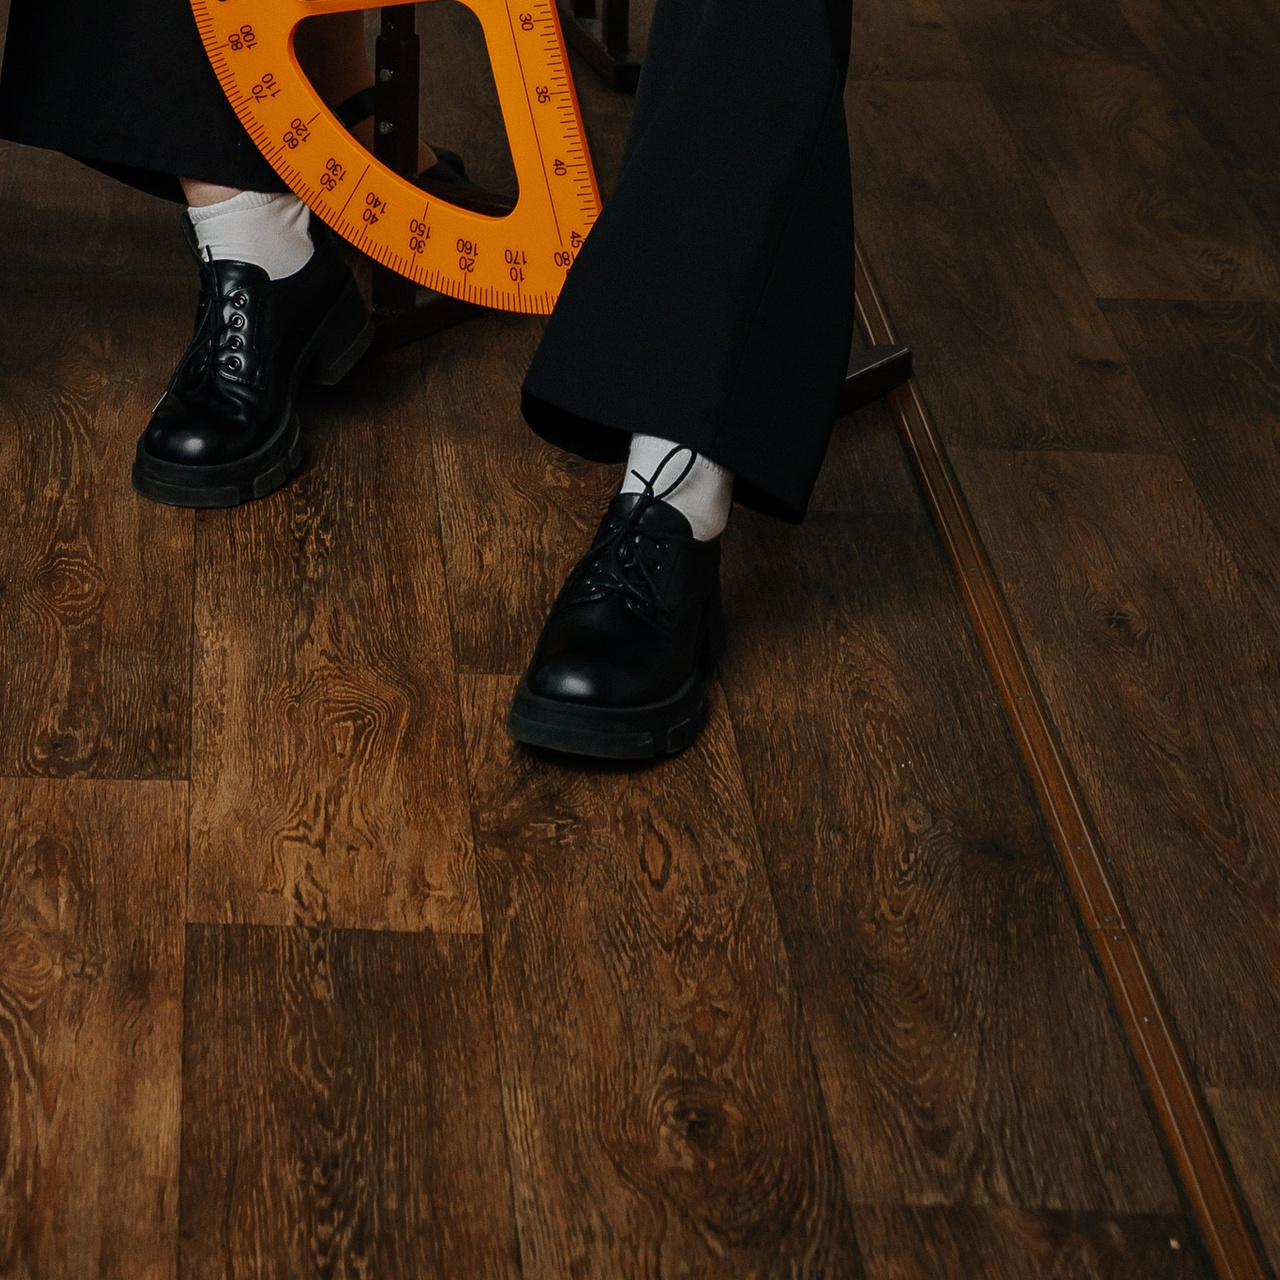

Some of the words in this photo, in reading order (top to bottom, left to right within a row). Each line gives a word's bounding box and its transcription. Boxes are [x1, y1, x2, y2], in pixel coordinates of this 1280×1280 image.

[519, 13, 534, 31] 30
[227, 33, 244, 51] 80
[239, 24, 258, 50] 100
[251, 83, 268, 103] 70
[261, 72, 281, 99] 110
[535, 85, 551, 104] 35
[290, 117, 312, 143] 120
[282, 131, 300, 150] 60
[325, 157, 347, 182] 130
[553, 158, 568, 177] 40
[320, 173, 338, 193] 50
[365, 191, 387, 215] 140
[362, 208, 380, 226] 40
[409, 219, 431, 240] 150
[409, 236, 427, 255] 30
[456, 238, 479, 257] 160
[458, 256, 475, 274] 20
[504, 249, 528, 266] 170
[509, 266, 525, 283] 10
